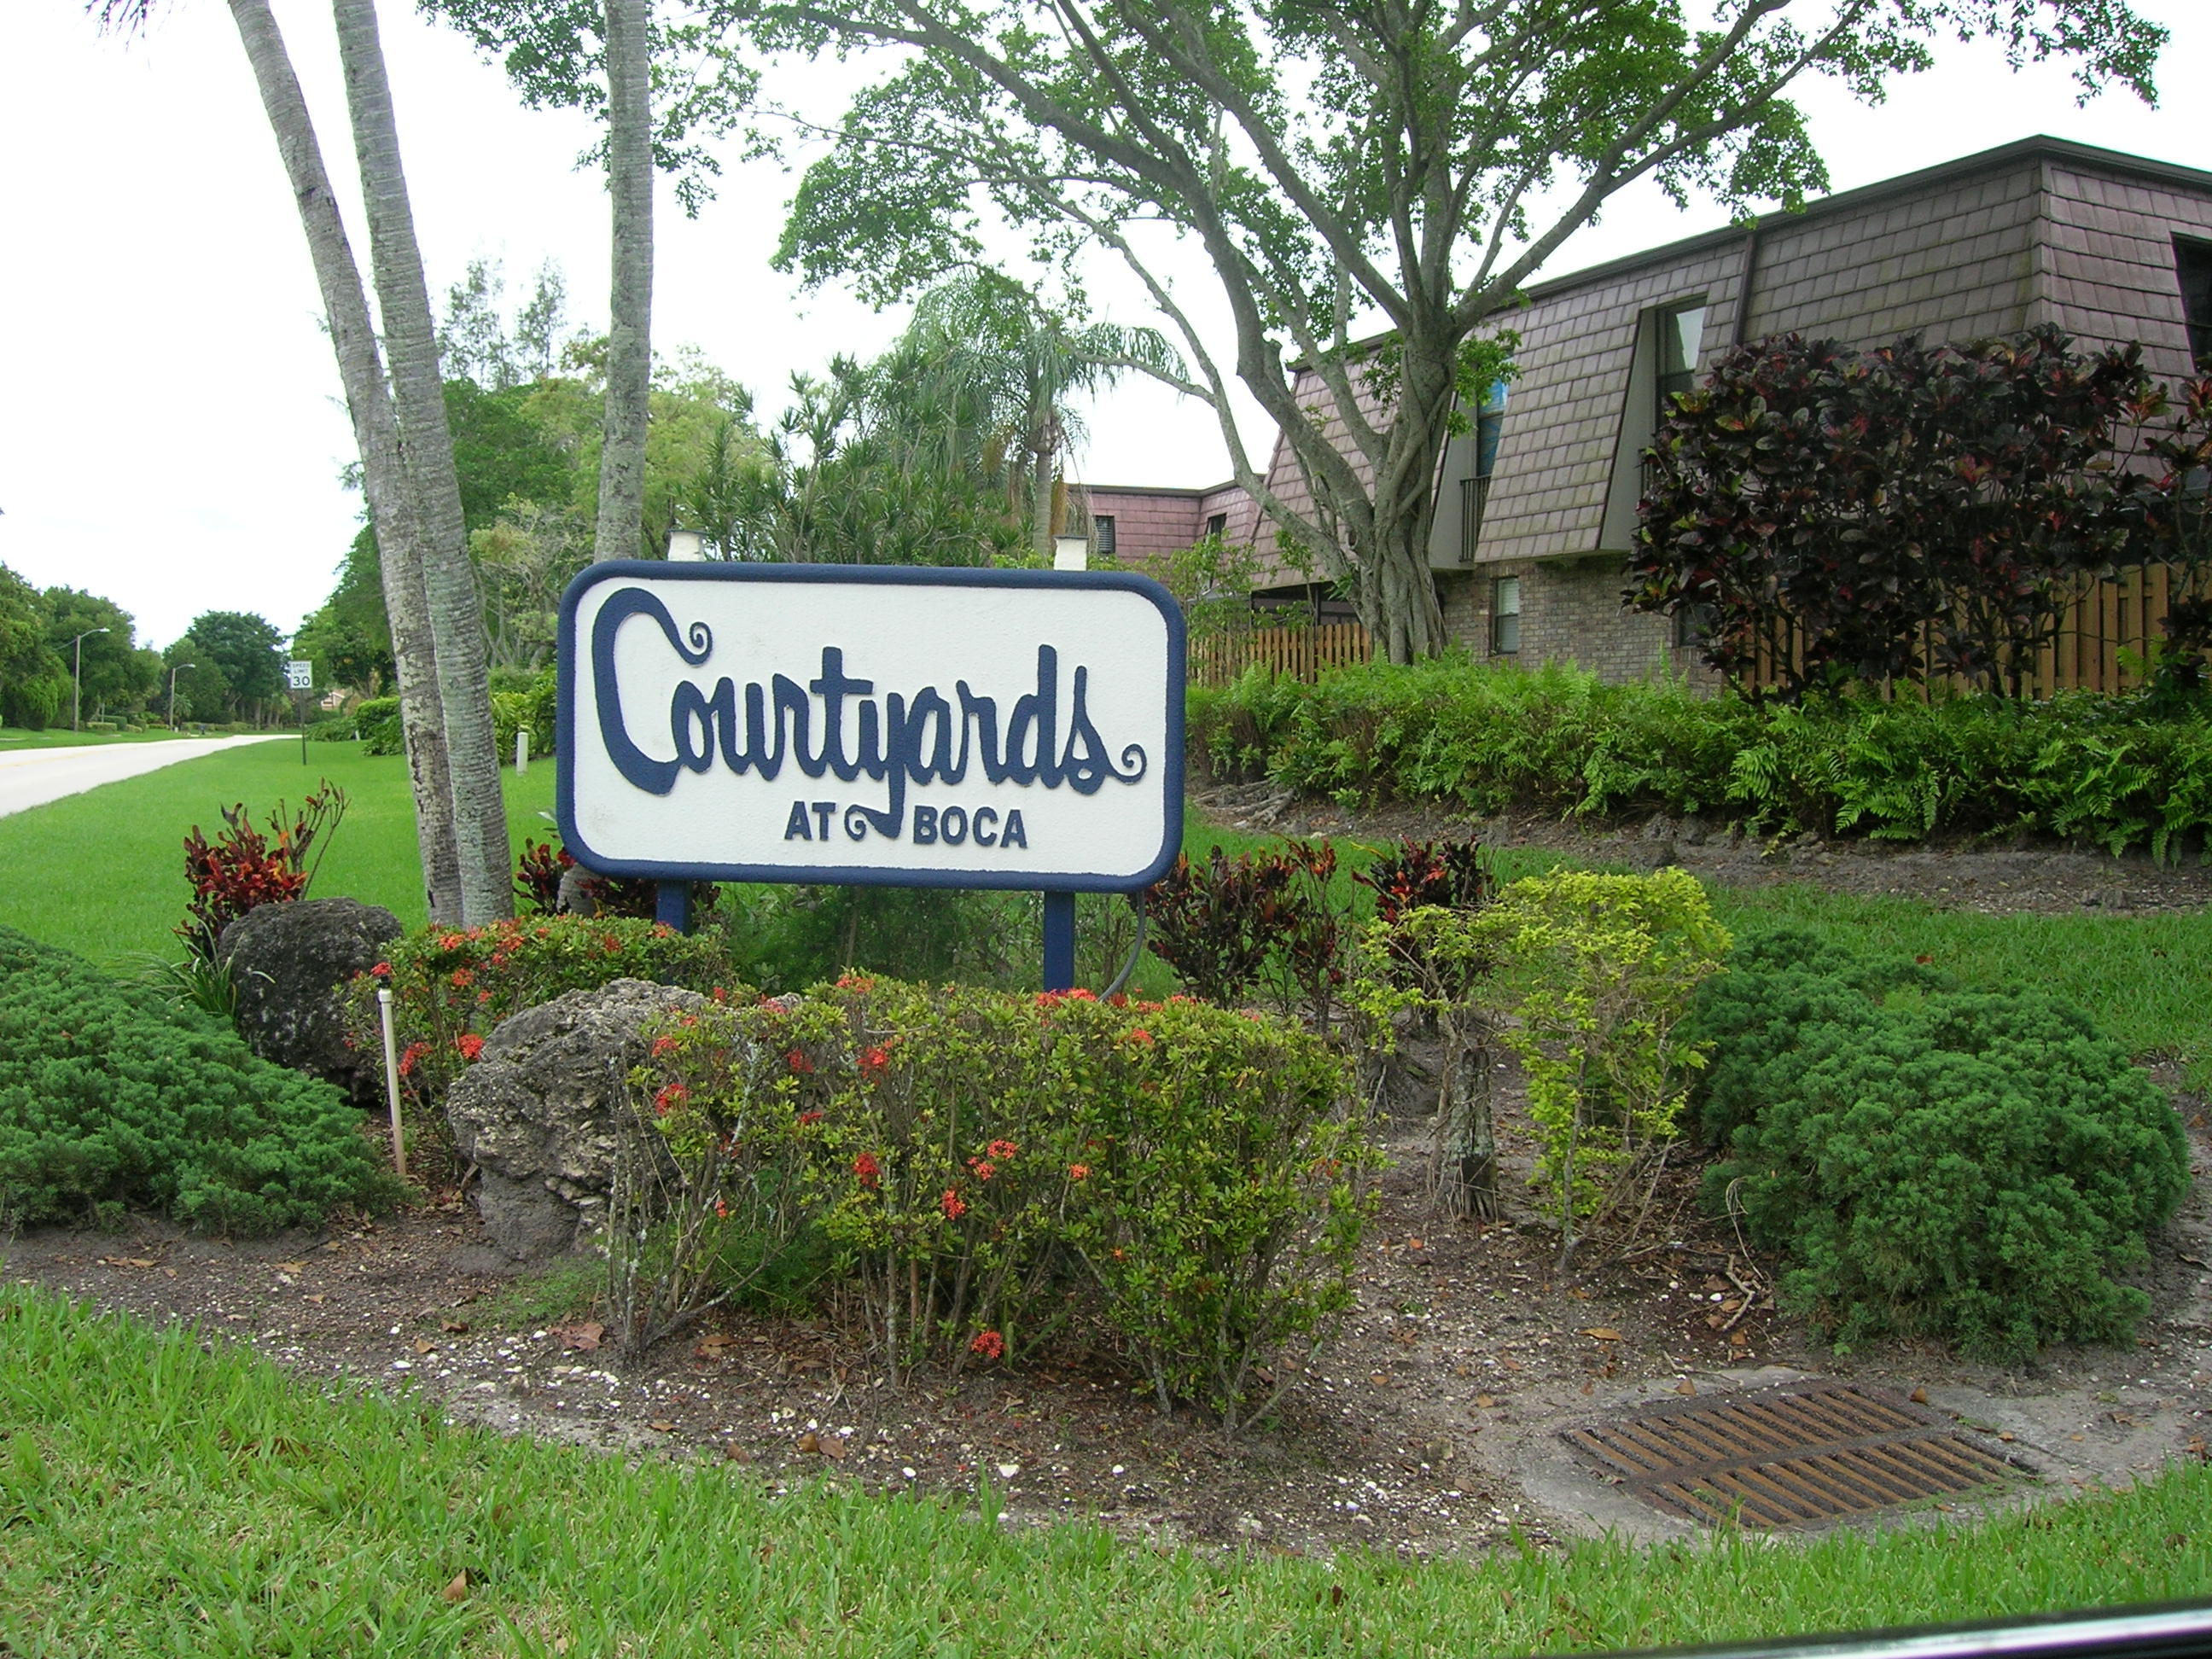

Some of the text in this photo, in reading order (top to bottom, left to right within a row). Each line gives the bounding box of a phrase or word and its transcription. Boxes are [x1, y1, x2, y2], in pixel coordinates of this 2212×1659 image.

[293, 676, 310, 686] 30
[591, 587, 1147, 840] Courtyards
[784, 800, 1027, 849] AT BOCA
